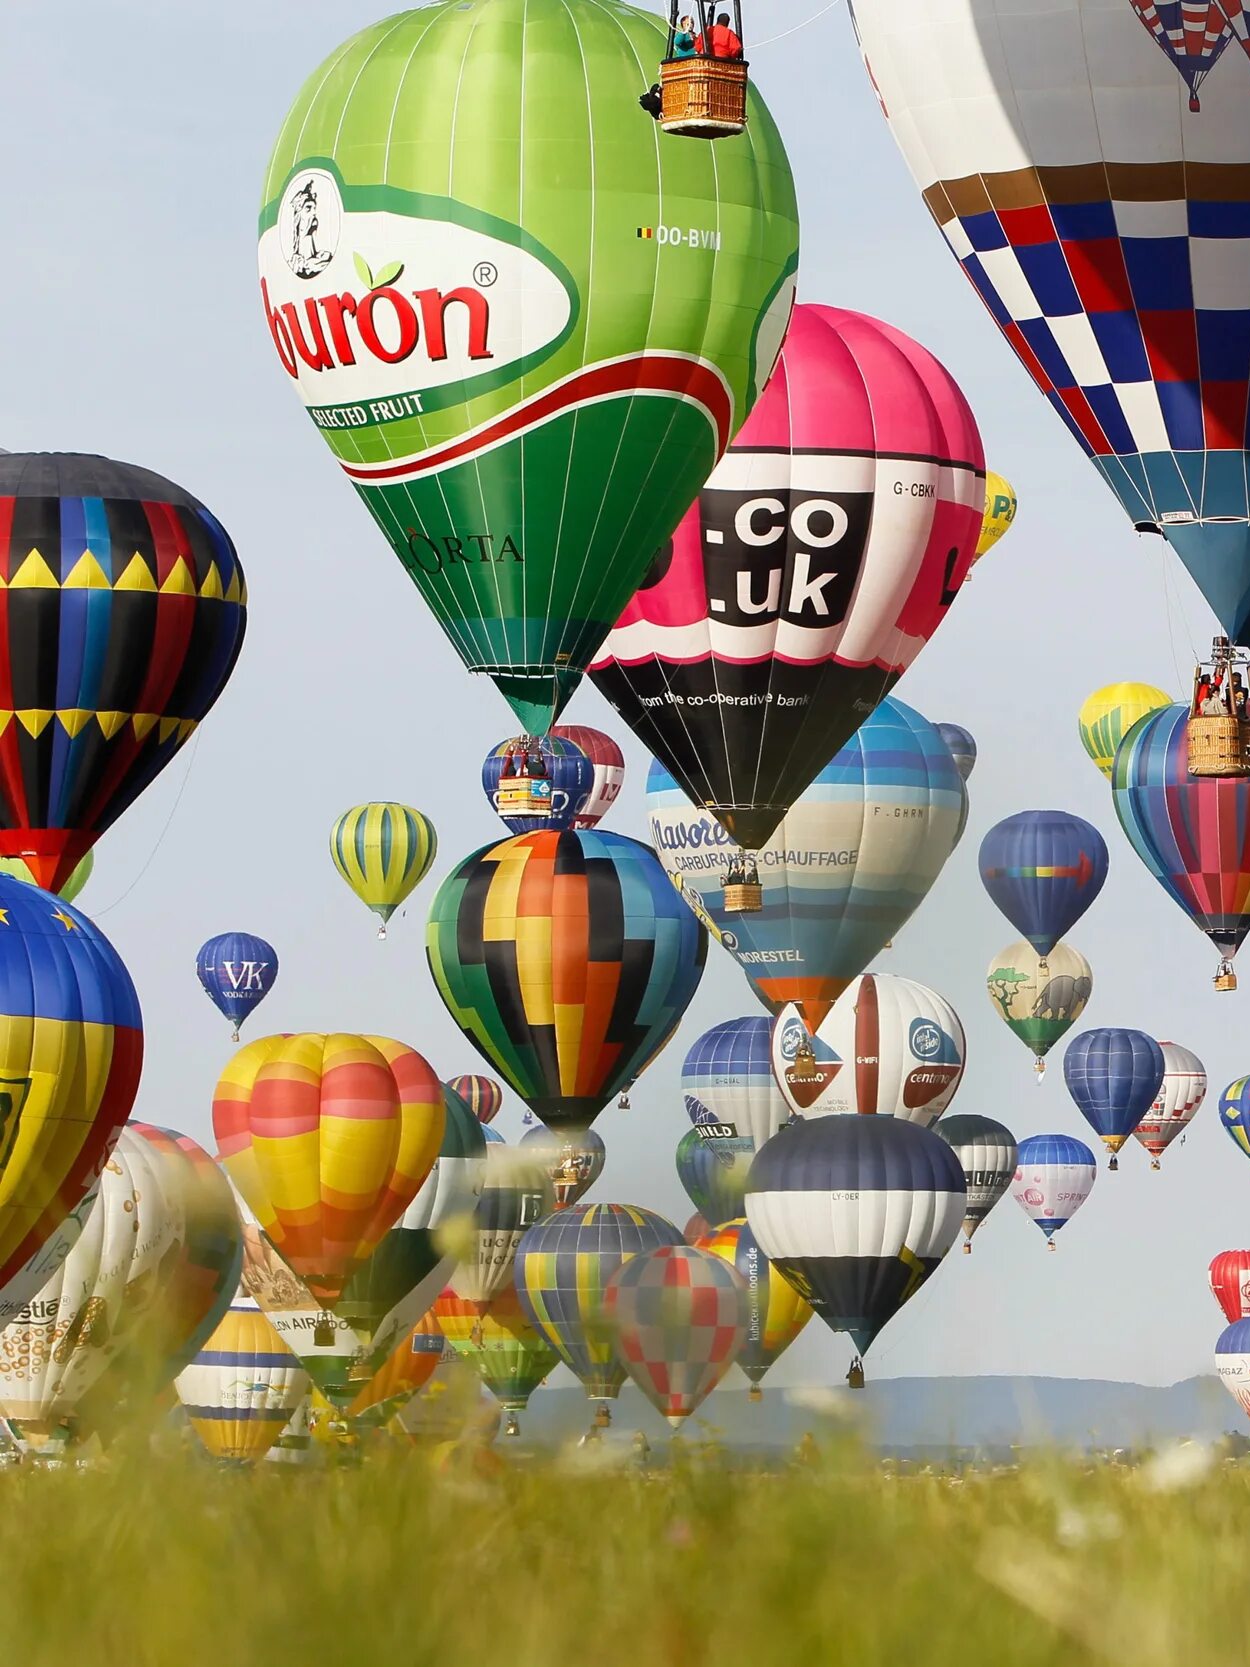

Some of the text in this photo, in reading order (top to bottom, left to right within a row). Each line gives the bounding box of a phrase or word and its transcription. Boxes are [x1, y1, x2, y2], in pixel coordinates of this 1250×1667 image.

[311, 393, 424, 428] SELECTED FRUIT
[705, 497, 848, 548] .co
[710, 552, 839, 616] .uk
[664, 691, 684, 706] the
[687, 692, 773, 707] co-operative
[777, 693, 810, 707] bank
[738, 949, 804, 964] MORESTEL
[223, 961, 269, 990] VK
